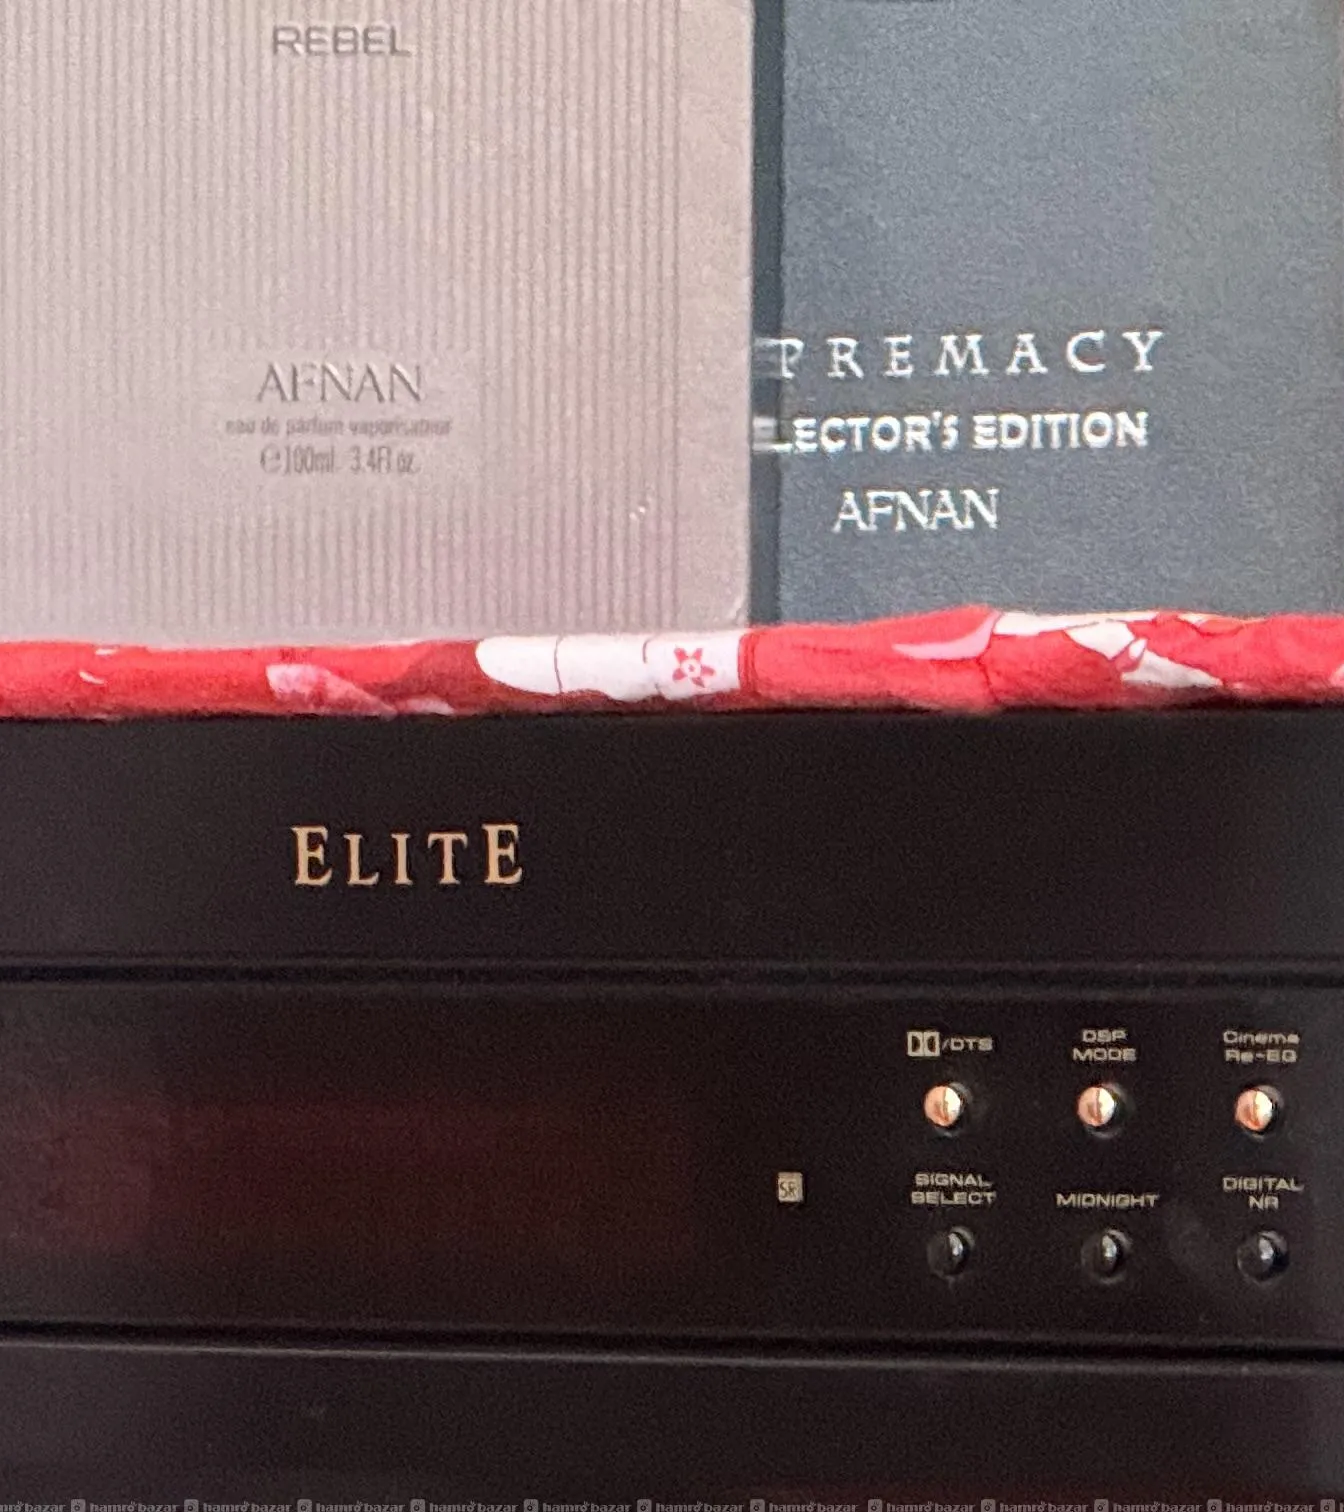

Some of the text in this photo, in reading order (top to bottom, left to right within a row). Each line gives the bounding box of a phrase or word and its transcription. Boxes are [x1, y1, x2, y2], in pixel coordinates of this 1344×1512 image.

[272, 25, 412, 57] REBEL
[256, 362, 422, 403] AFNAN
[972, 411, 1149, 450] EDITION
[832, 488, 1000, 533] AFNAN
[290, 823, 523, 887] ELITE
[1081, 1029, 1127, 1045] DSP
[1222, 1030, 1301, 1045] Cinema
[1072, 1047, 1137, 1062] MODE
[1225, 1048, 1298, 1063] Re-EQ
[914, 1172, 992, 1188] SIGNAL
[1222, 1176, 1305, 1192] DIGITAL
[910, 1190, 997, 1205] SELECT
[1055, 1193, 1160, 1209] MIDNIGHT
[1248, 1193, 1279, 1210] NR
